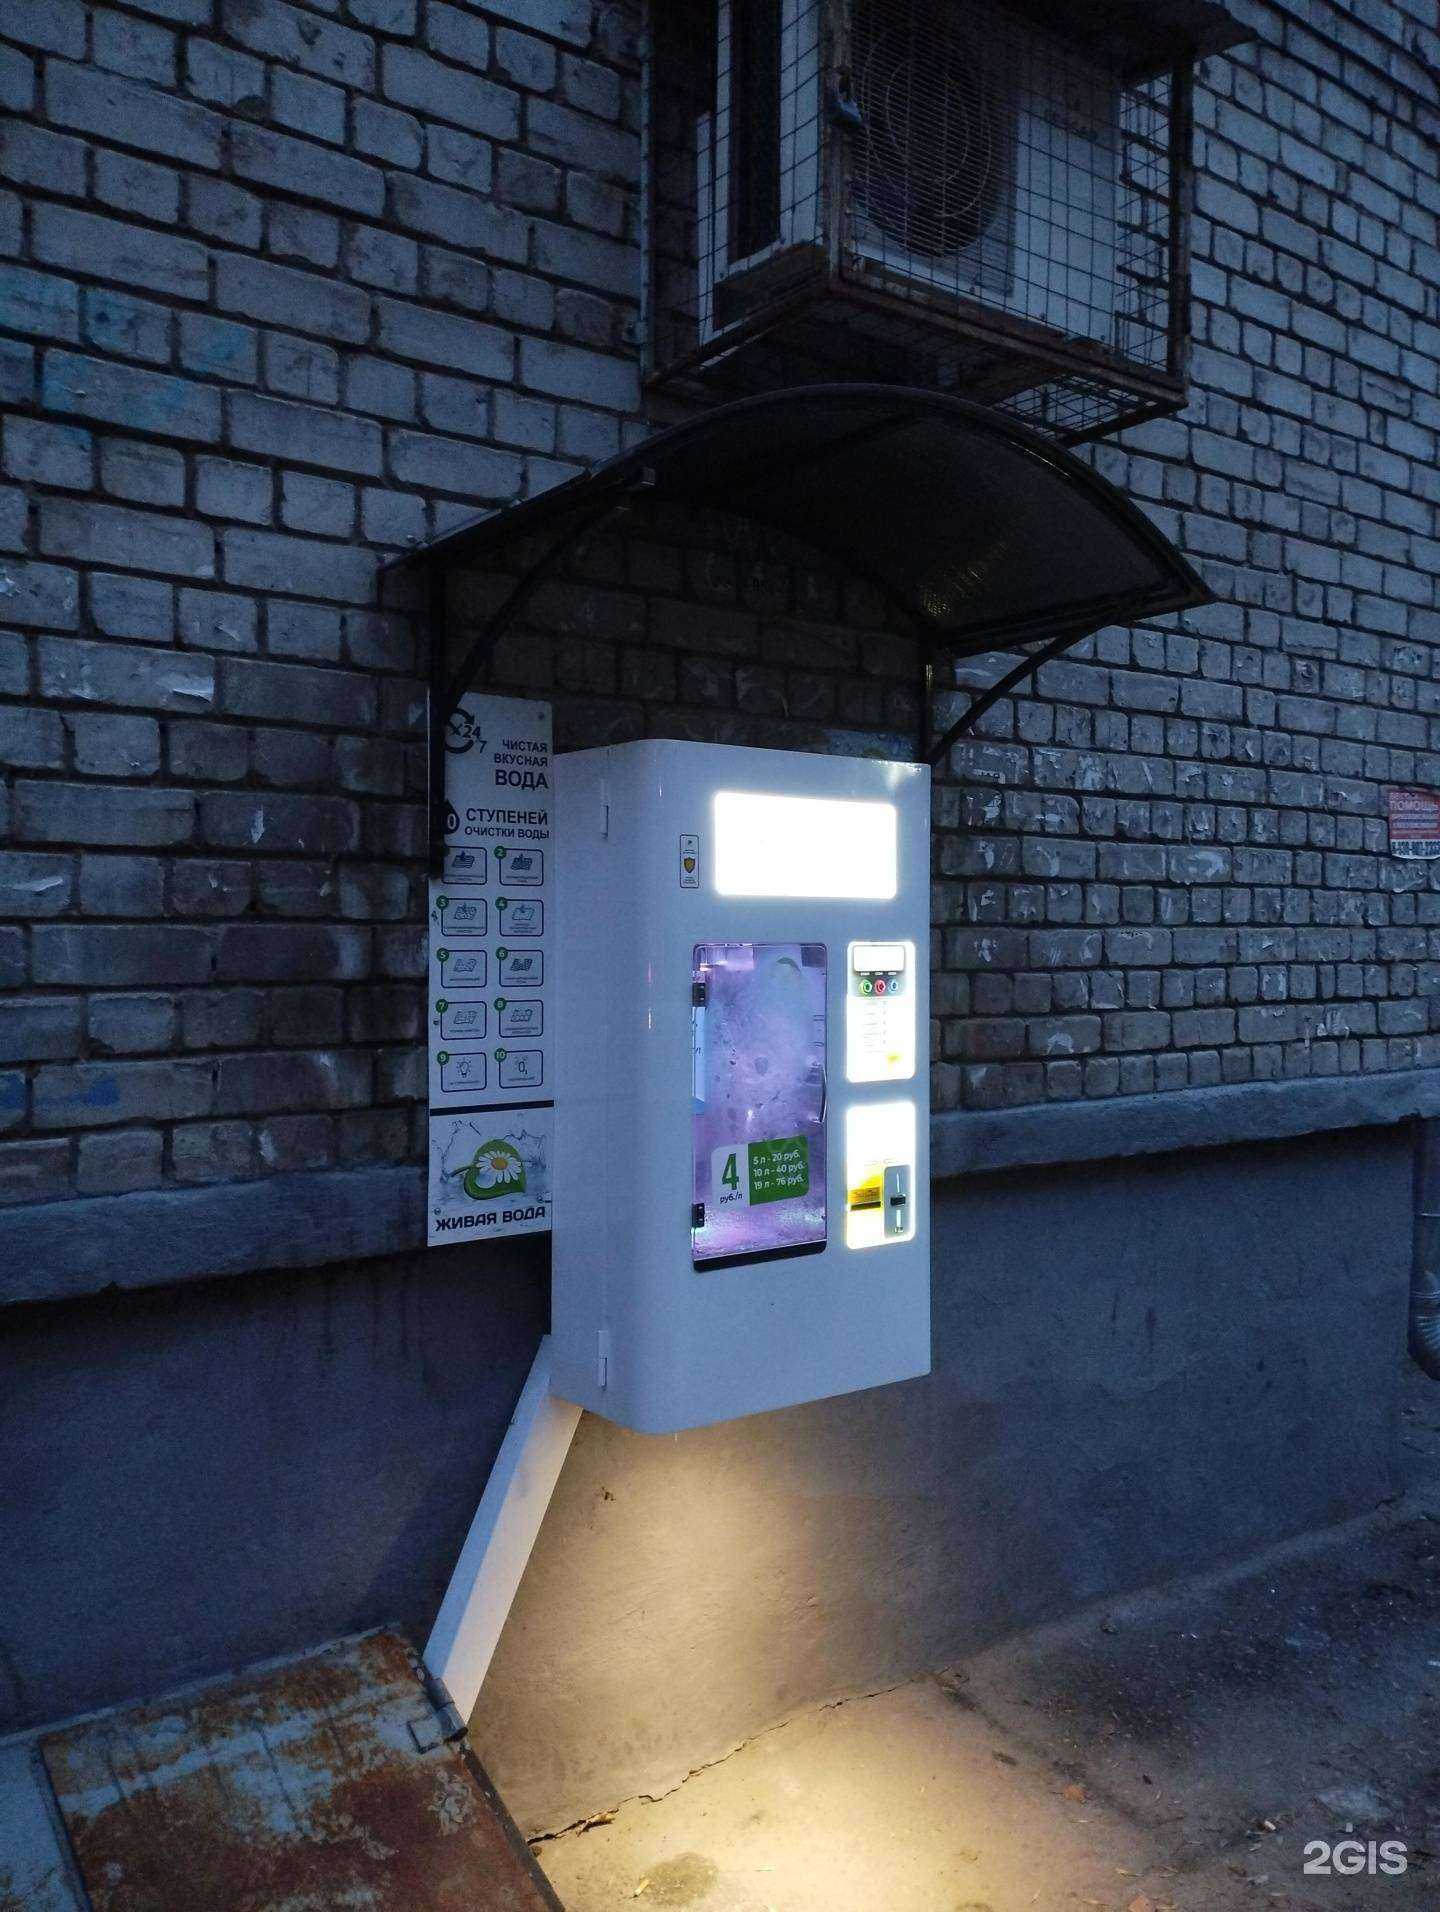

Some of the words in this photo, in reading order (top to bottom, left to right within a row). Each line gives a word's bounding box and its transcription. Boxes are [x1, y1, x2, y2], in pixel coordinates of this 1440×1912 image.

[502, 739, 548, 753] ЧИСТАЯ
[494, 753, 548, 767] ВКУСНАЯ
[495, 769, 549, 791] ВОДА
[465, 807, 548, 826] СТУПЕНЕЙ
[464, 826, 515, 838] ОЧИСТКИ
[517, 827, 549, 840] ВОДЫ
[753, 1156, 759, 1165] 5
[772, 1152, 782, 1162] 20
[721, 1153, 739, 1190] 4
[753, 1168, 763, 1177] 10
[776, 1164, 788, 1173] 40
[754, 1180, 763, 1190] 19
[776, 1177, 787, 1186] 76
[435, 1213, 497, 1232] ЖИВАЯ
[502, 1206, 546, 1223] ВОДА
